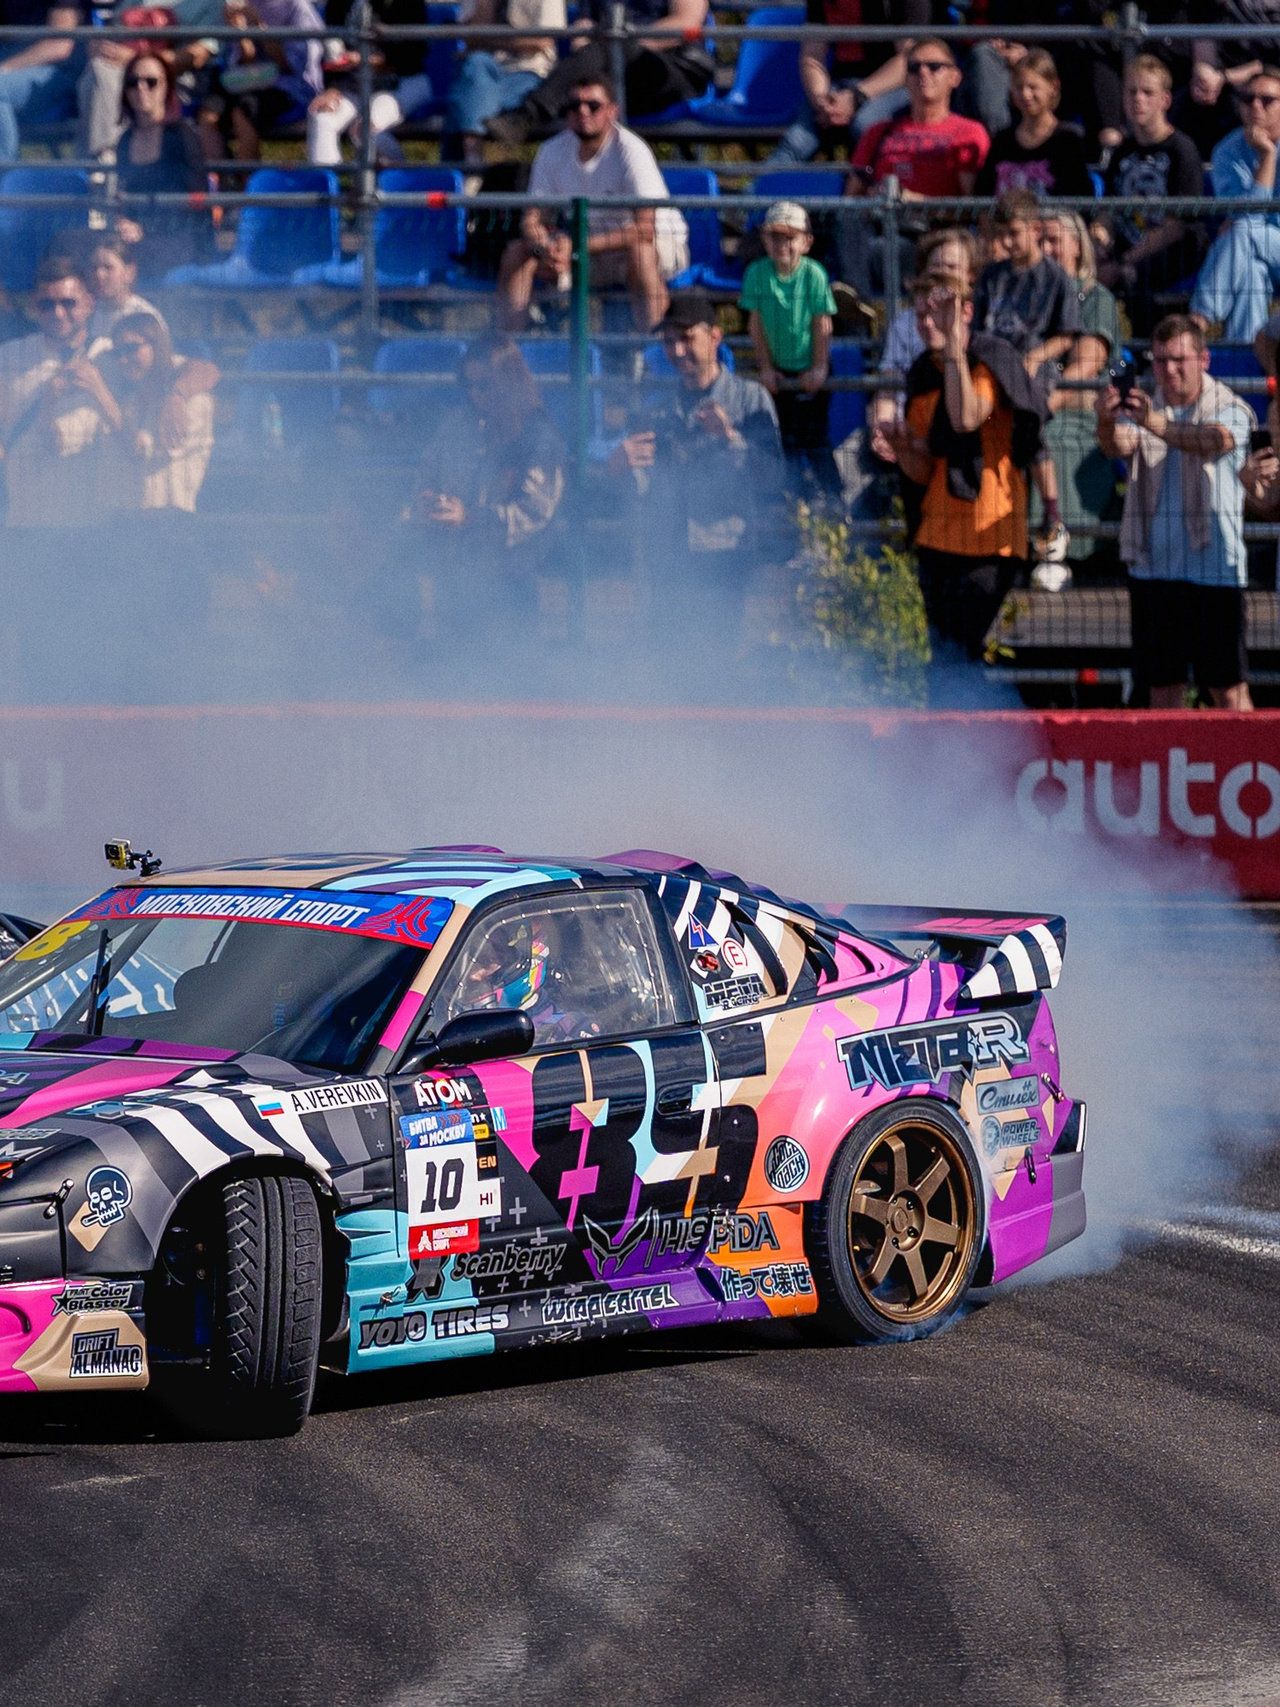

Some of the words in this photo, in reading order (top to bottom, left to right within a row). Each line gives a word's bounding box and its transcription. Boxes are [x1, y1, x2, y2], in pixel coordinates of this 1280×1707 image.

[129, 893, 295, 920] МОСКОВСКИЙ
[278, 899, 371, 929] СПОРТ
[414, 1079, 472, 1107] ATOM
[408, 1115, 439, 1137] БИТВА
[419, 1134, 429, 1146] ЗА
[429, 1123, 466, 1146] МОСКВУ
[1002, 1130, 1039, 1146] WHEELS
[1004, 1121, 1037, 1134] POWER
[420, 1157, 465, 1214] 10
[451, 1243, 567, 1280] Scanberry
[91, 1285, 130, 1298] Color
[721, 1264, 814, 1302] 作って壊せ
[68, 1298, 128, 1311] Blaster
[359, 1311, 427, 1349] YOYO
[433, 1304, 510, 1338] TIRES
[77, 1335, 113, 1353] DRIFT
[73, 1347, 142, 1374] ALMANAC
